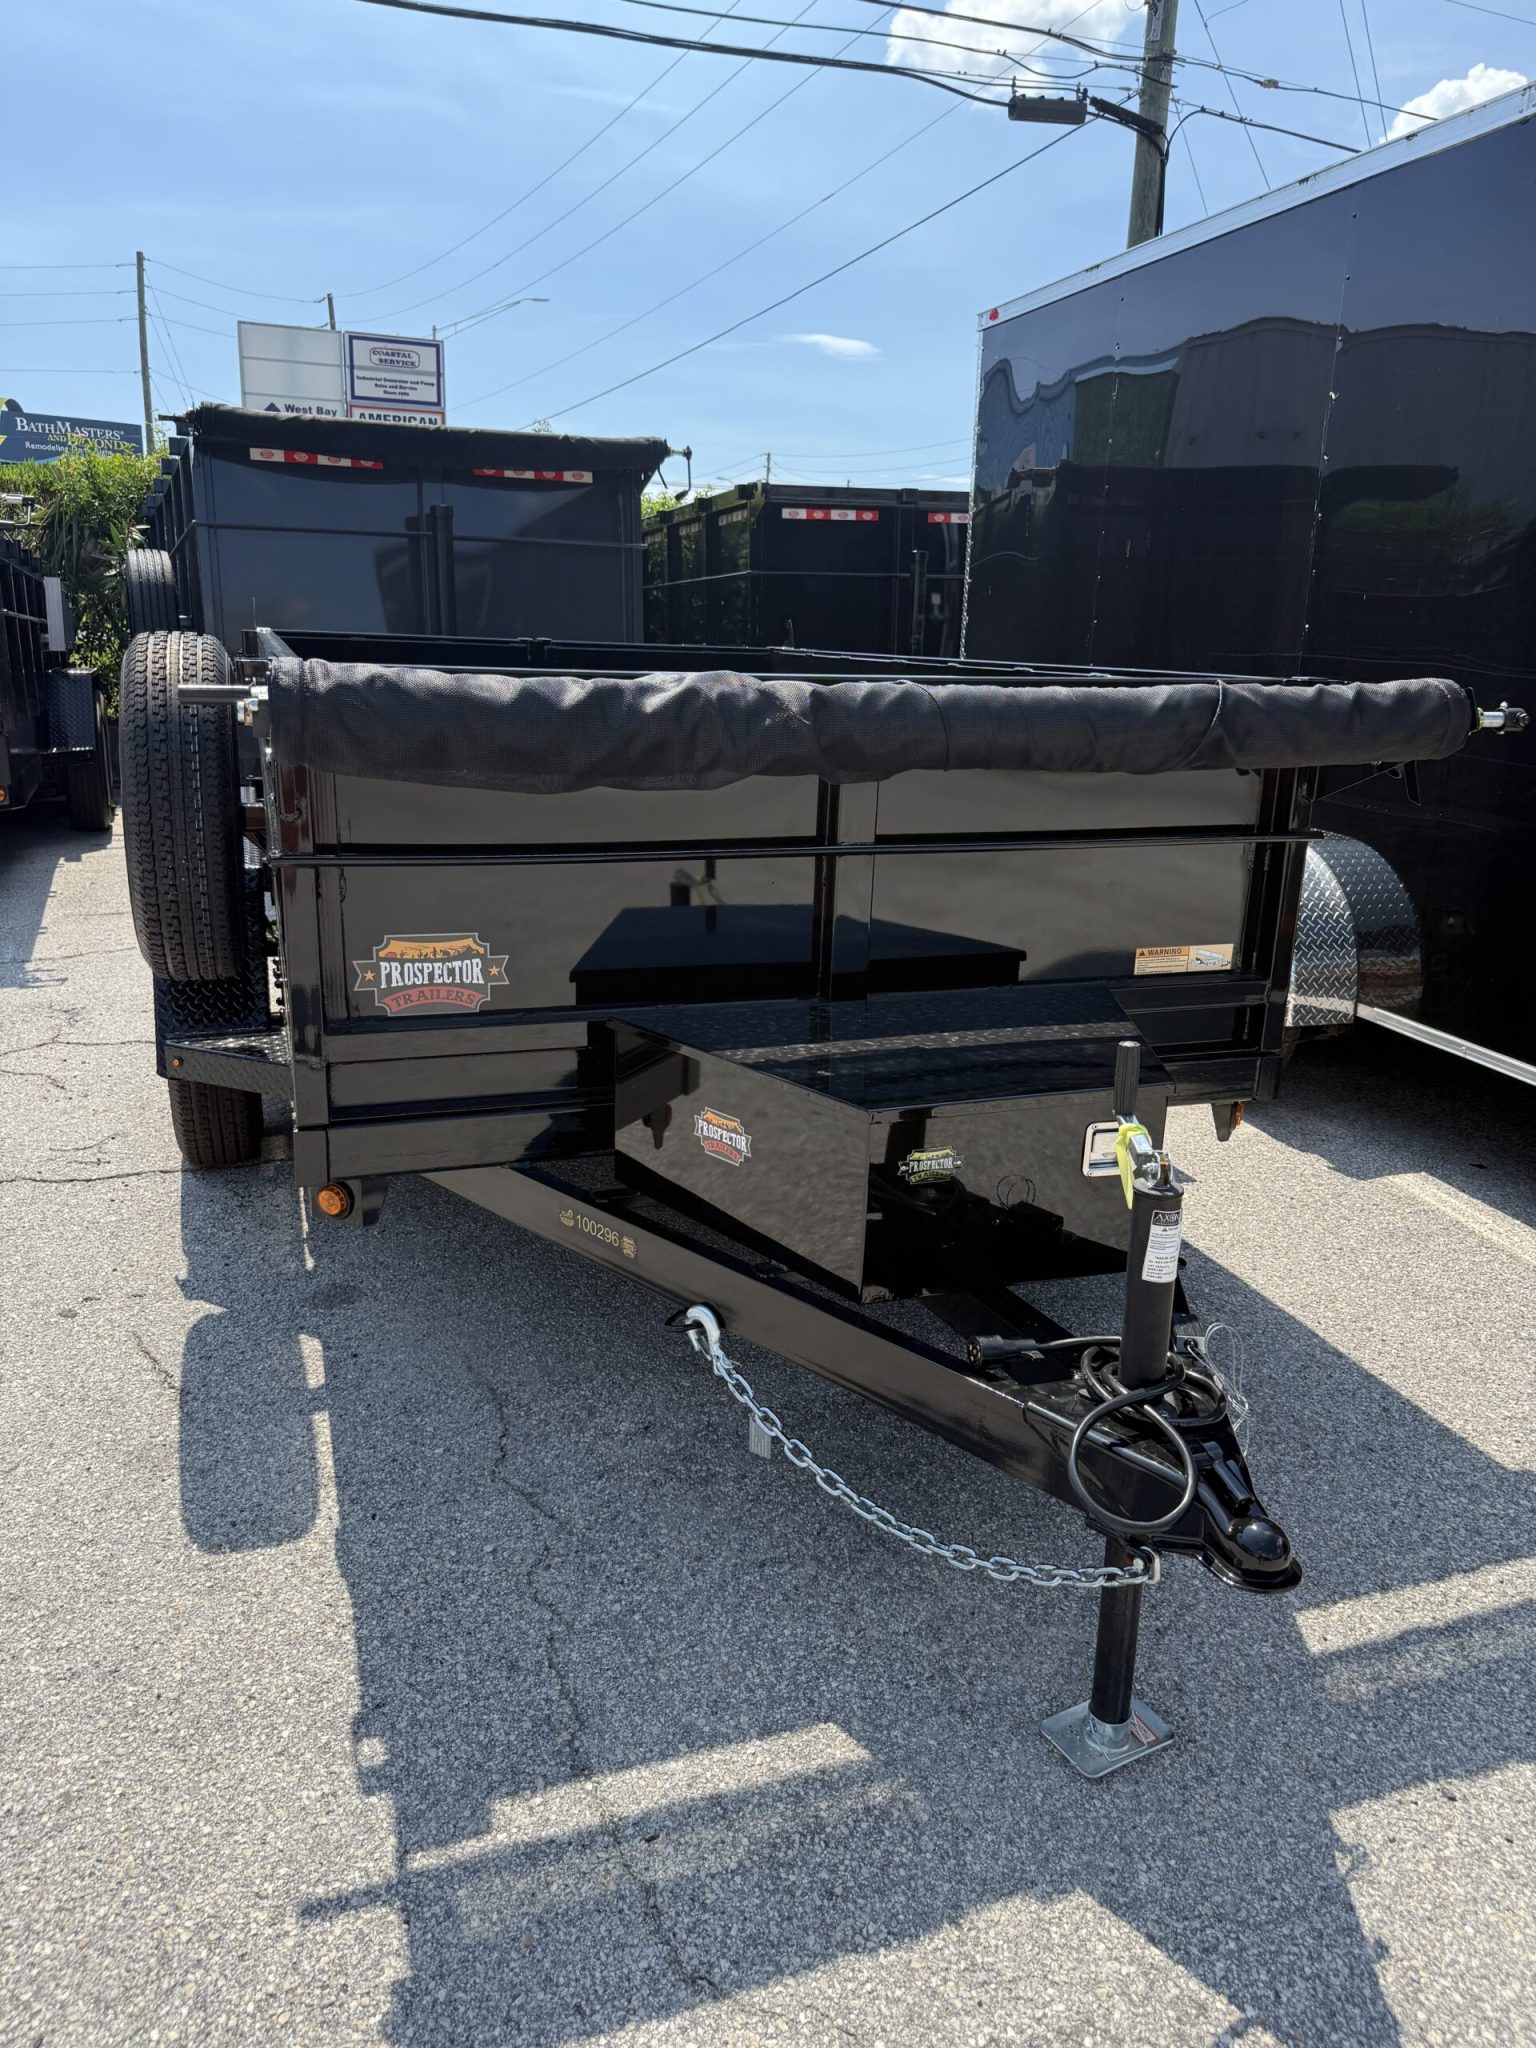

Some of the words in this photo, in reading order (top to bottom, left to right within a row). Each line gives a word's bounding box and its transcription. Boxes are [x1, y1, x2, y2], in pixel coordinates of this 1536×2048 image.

[372, 349, 413, 360] COASTAL
[378, 358, 416, 368] SERVICE
[284, 403, 313, 415] West
[316, 406, 338, 418] Bay
[1147, 947, 1182, 956] WARNING
[380, 958, 485, 989] PROSPECTOR
[390, 989, 476, 1007] TRAILERS
[698, 1118, 748, 1153] PROSPECTOR
[909, 1157, 954, 1174] PROSPECTOR
[576, 1213, 620, 1248] 100296
